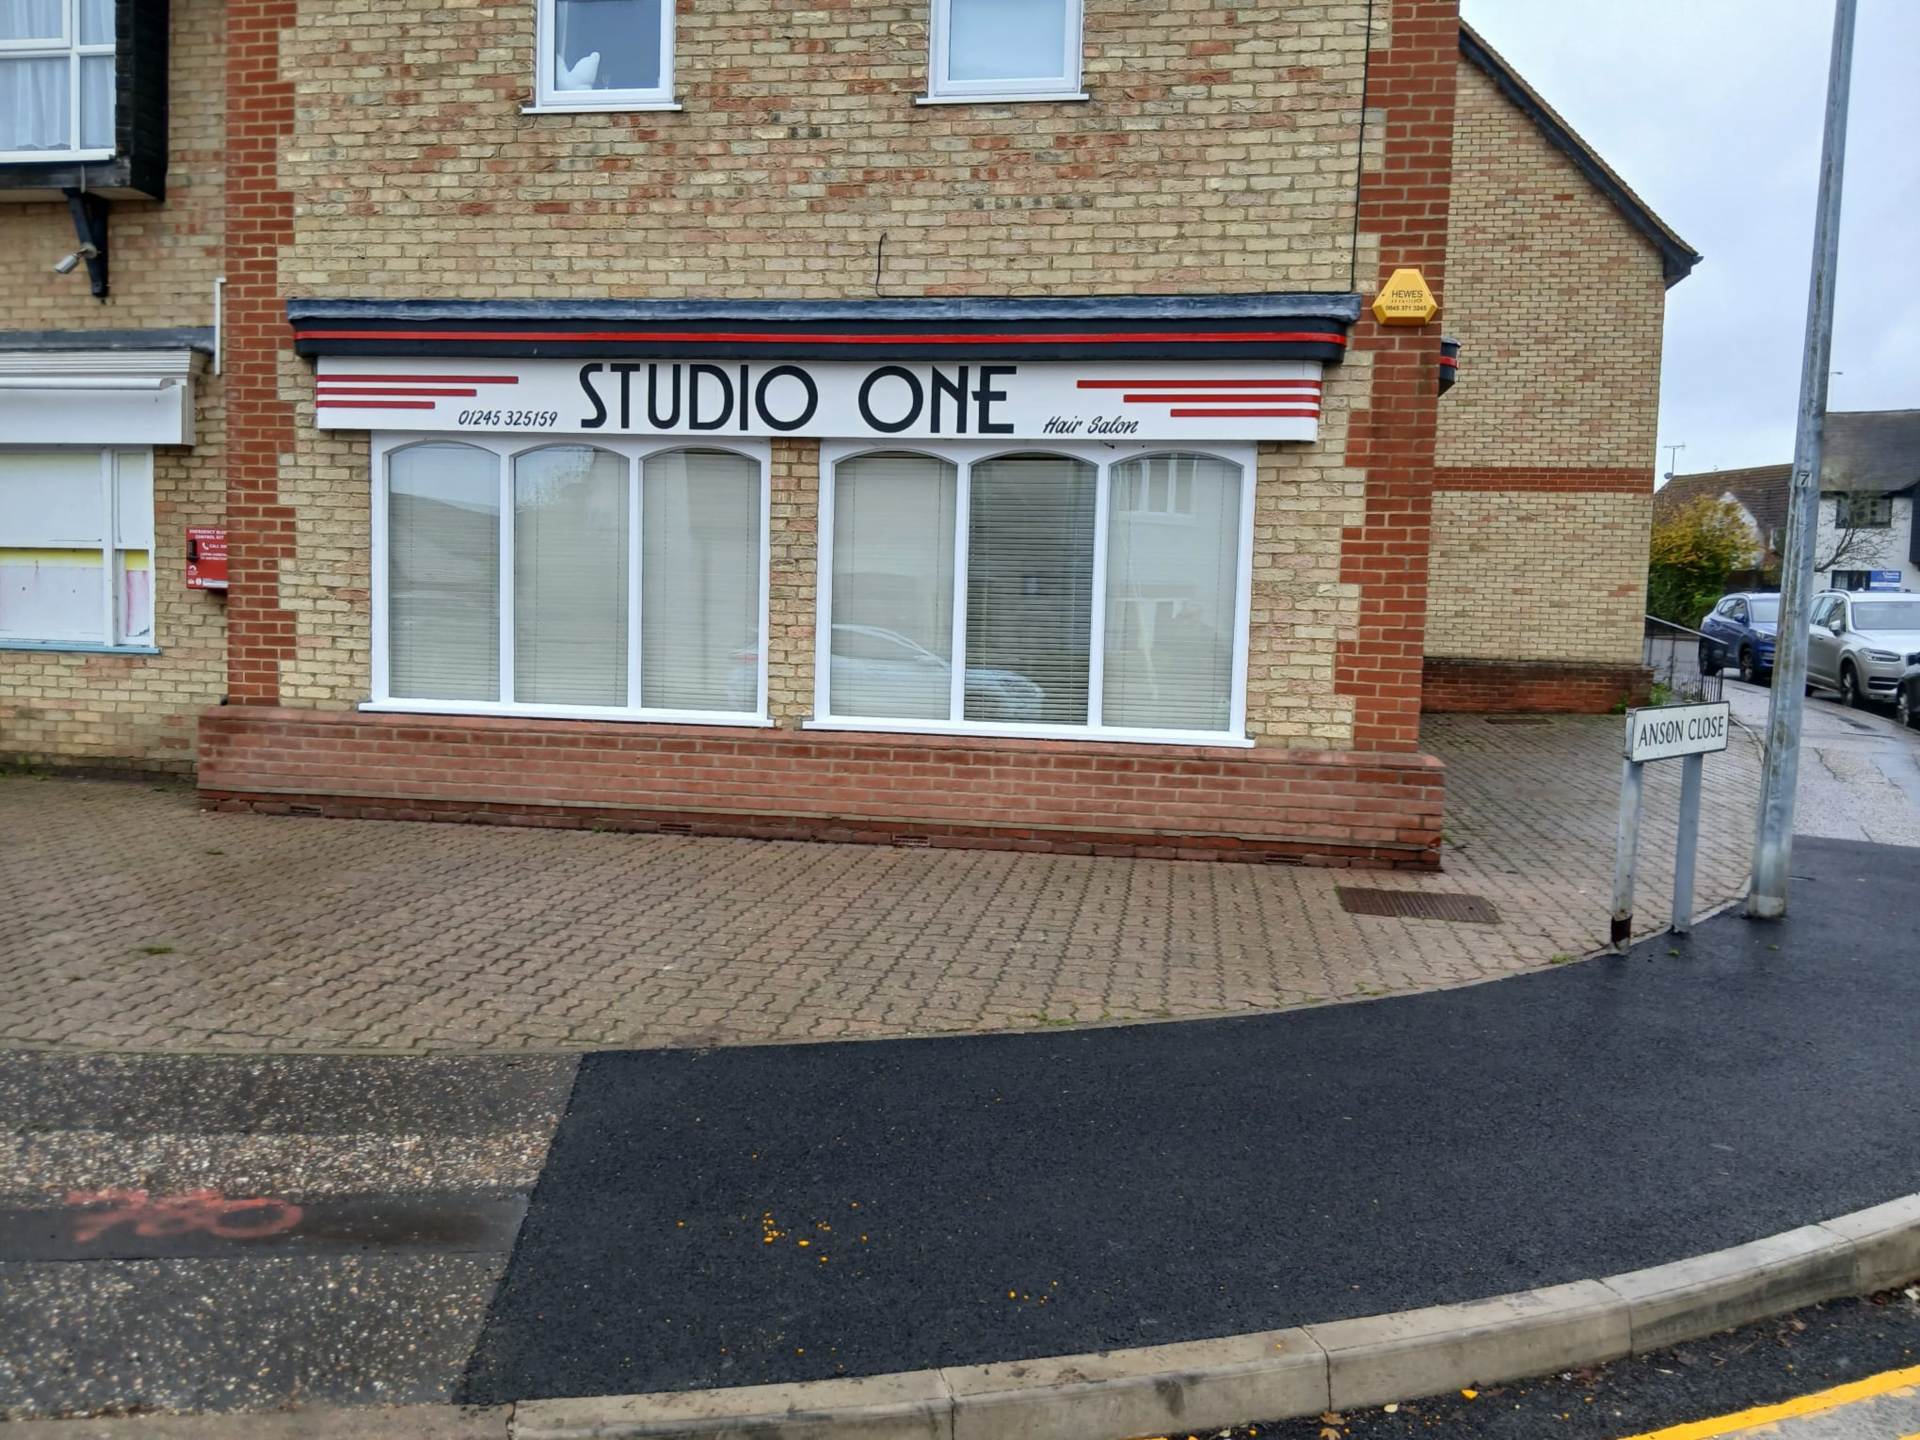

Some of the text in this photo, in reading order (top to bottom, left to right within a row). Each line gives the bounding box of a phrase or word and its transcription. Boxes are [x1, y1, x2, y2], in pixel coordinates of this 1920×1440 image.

[1391, 289, 1424, 299] HEWES
[579, 363, 1018, 434] STUDIO ONE
[458, 409, 558, 427] 01245 325159
[1042, 415, 1139, 434] Hair Salon
[1800, 473, 1810, 486] 7
[1638, 715, 1725, 747] ANSON CLOSE
